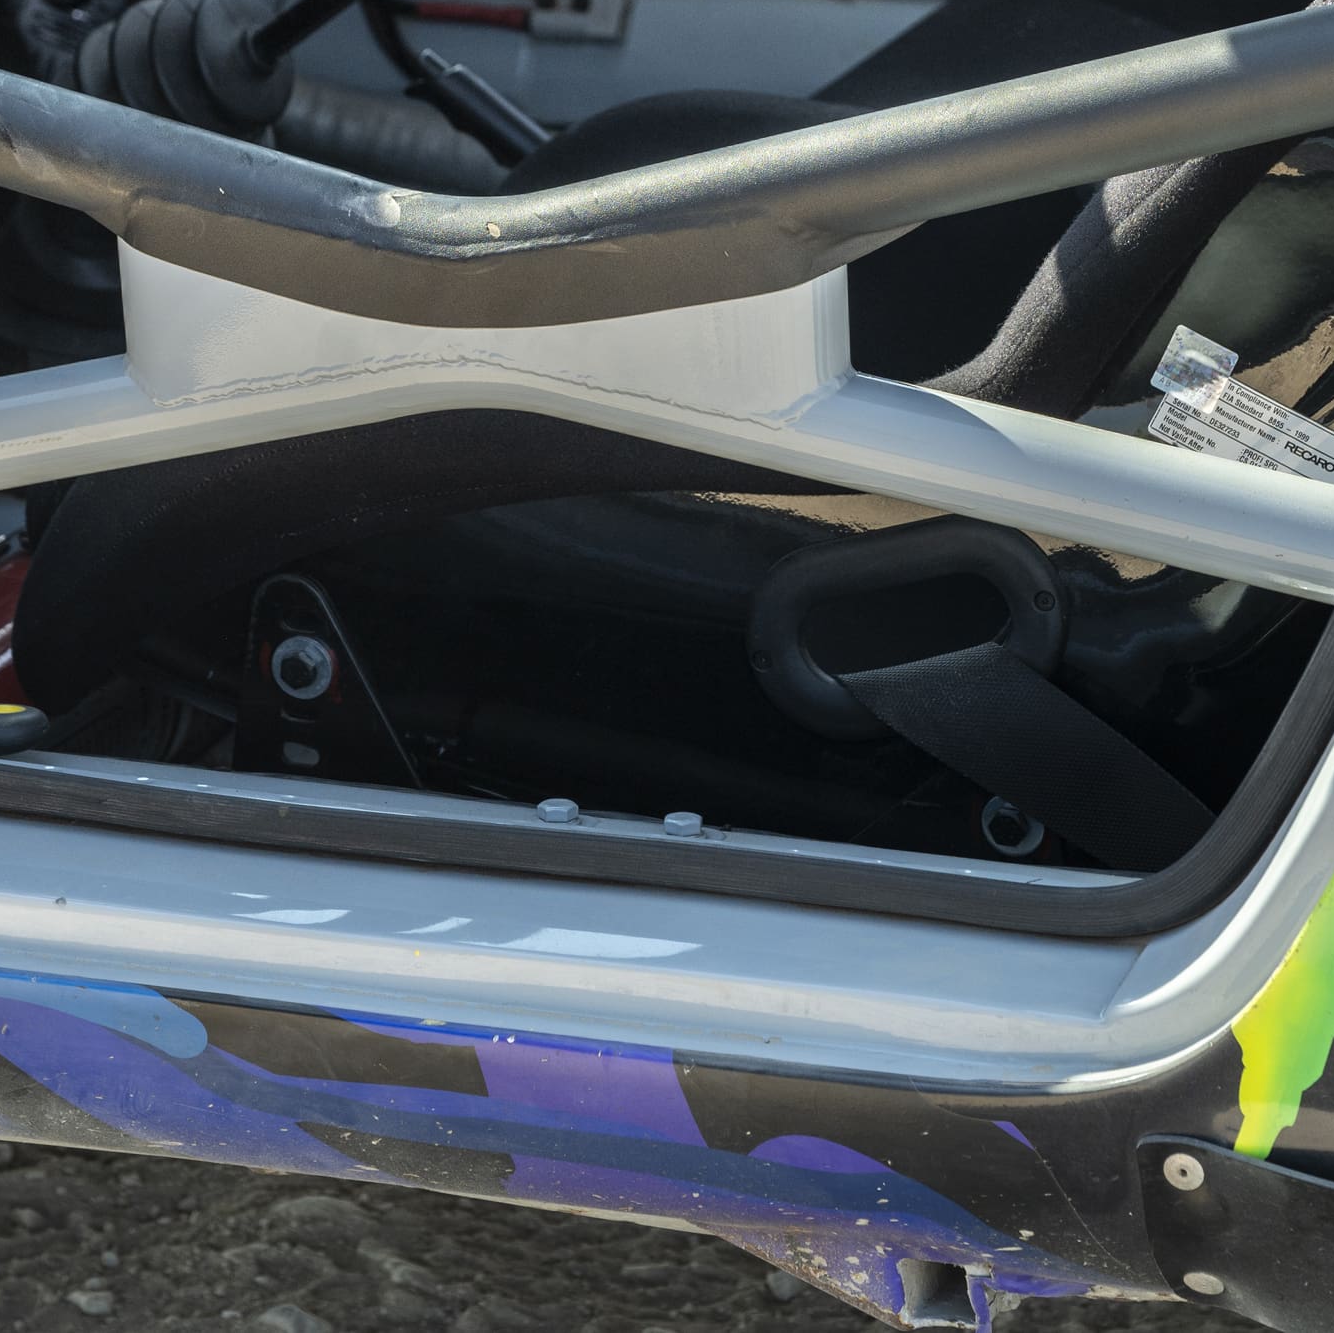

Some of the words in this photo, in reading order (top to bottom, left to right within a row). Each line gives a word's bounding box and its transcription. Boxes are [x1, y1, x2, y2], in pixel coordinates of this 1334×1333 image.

[1172, 397, 1192, 411] Serial
[1227, 383, 1236, 393] In
[1235, 386, 1272, 412] Compliance
[1168, 407, 1188, 422] Model
[1215, 405, 1258, 432] Manufacturer
[1256, 428, 1277, 444] Name
[1222, 392, 1235, 404] FIA
[1235, 398, 1264, 419] Standard
[1268, 416, 1285, 430] 8855
[1294, 429, 1311, 443] 1999
[1159, 423, 1171, 433] Not
[1171, 429, 1188, 444] Valid
[1163, 416, 1208, 443] Homologation
